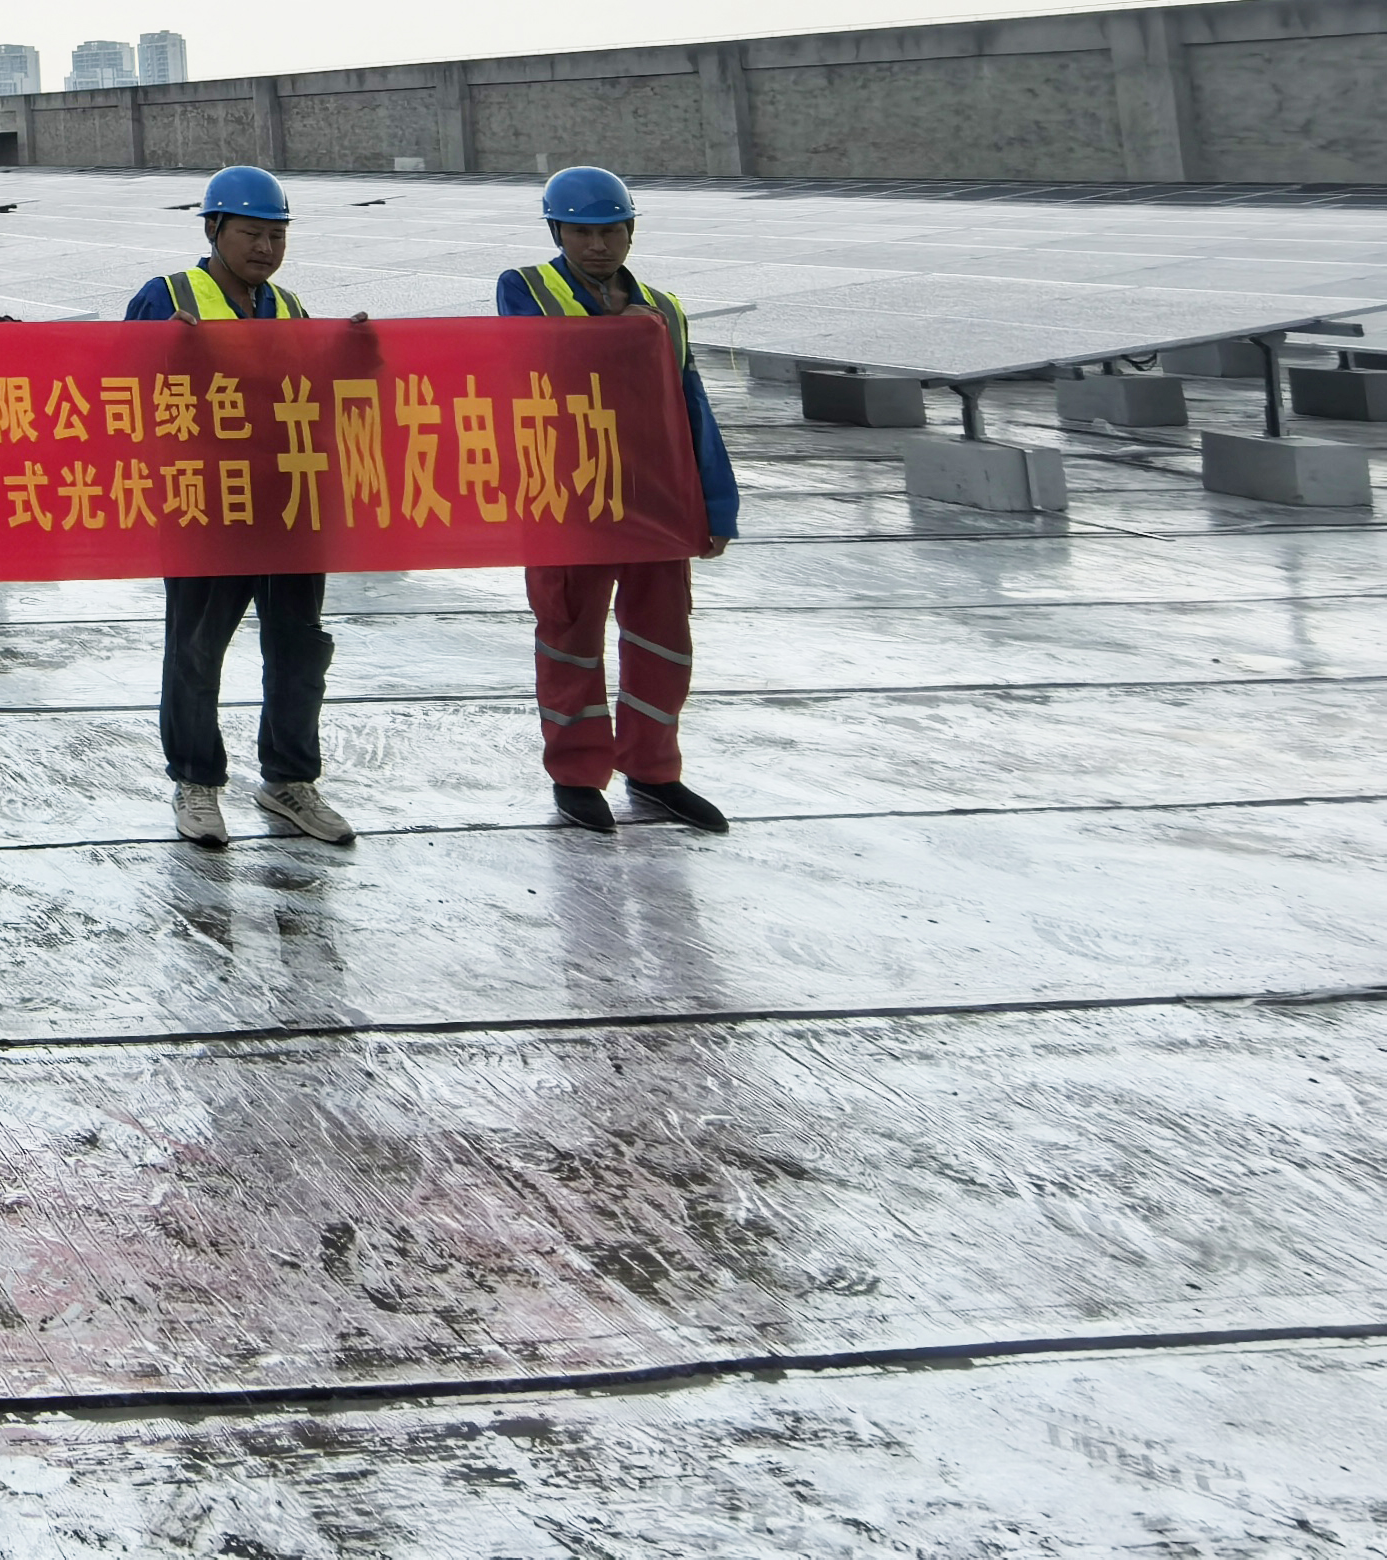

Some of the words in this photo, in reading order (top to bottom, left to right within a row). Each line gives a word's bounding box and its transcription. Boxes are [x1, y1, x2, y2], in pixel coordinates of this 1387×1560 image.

[272, 372, 625, 531] 并网发电成功
